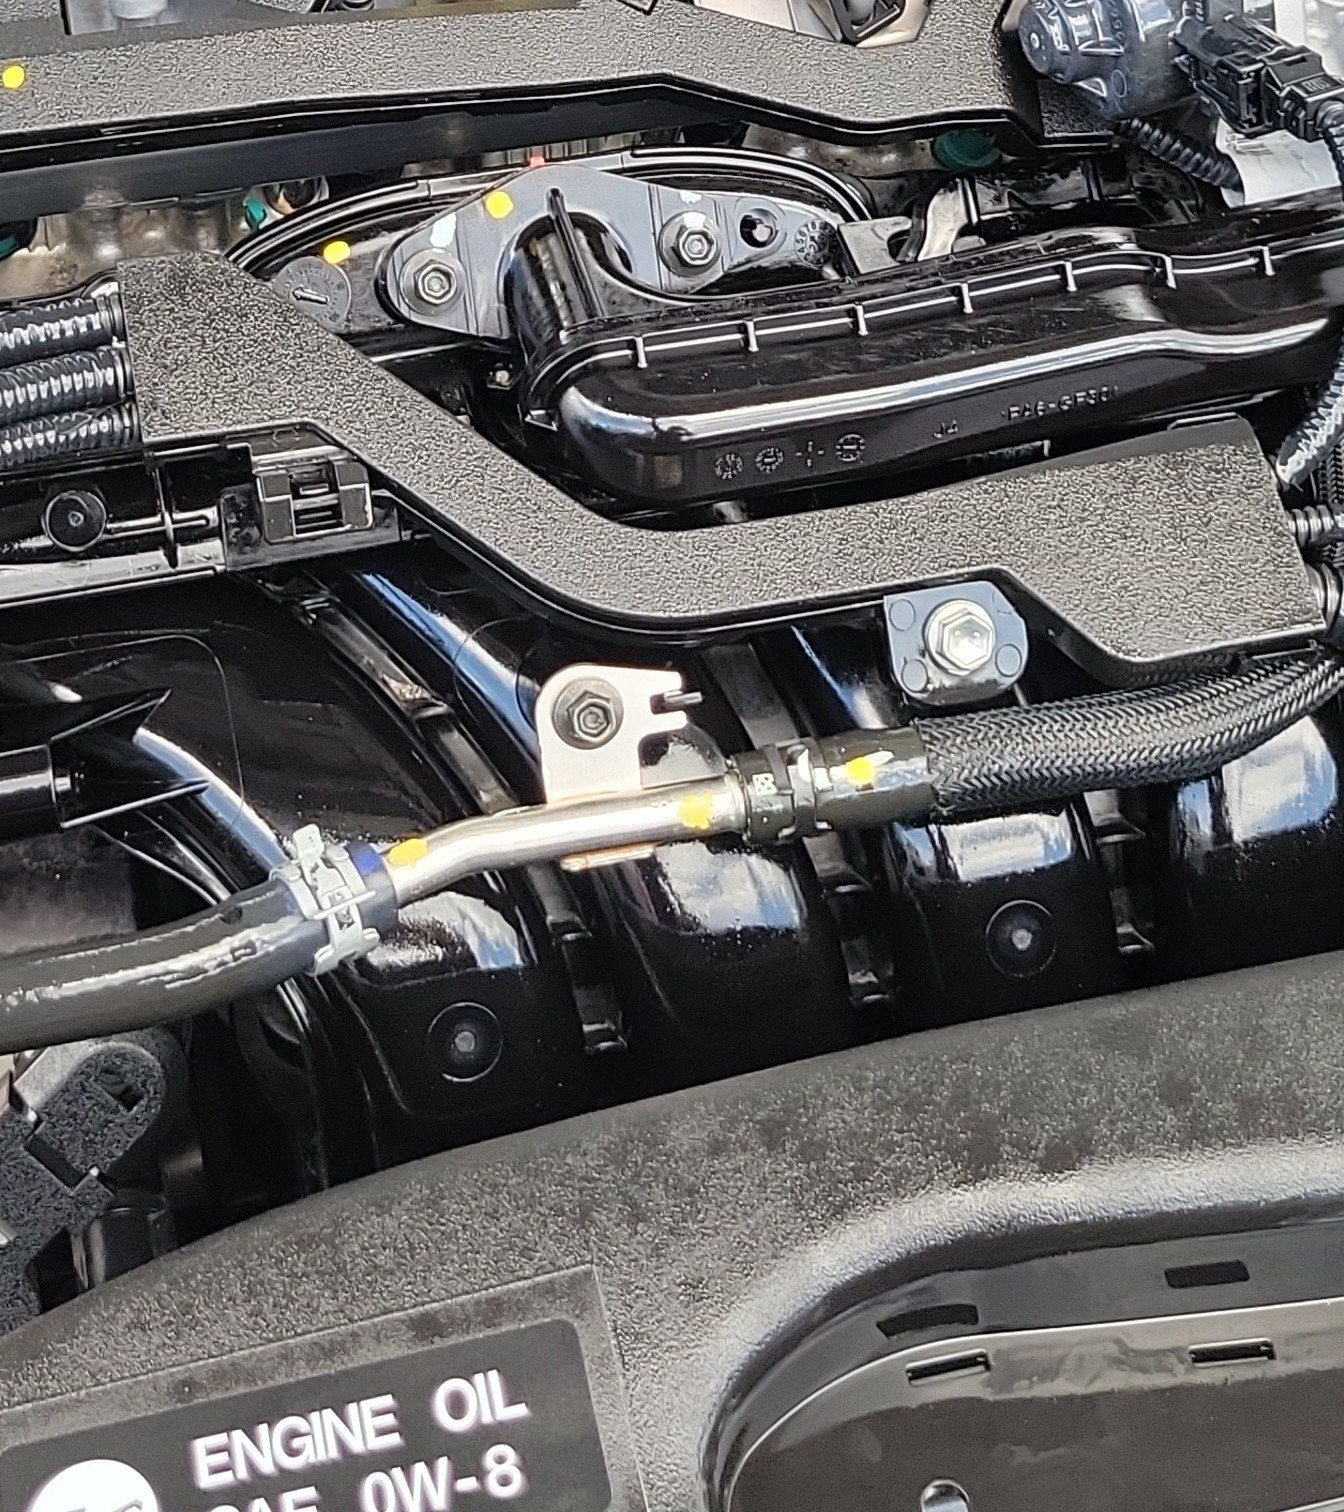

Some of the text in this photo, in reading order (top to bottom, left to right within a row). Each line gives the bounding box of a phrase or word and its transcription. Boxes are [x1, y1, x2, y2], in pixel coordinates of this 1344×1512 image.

[194, 1369, 531, 1490] ENGINE OIL
[361, 1445, 524, 1512] 0W-8
